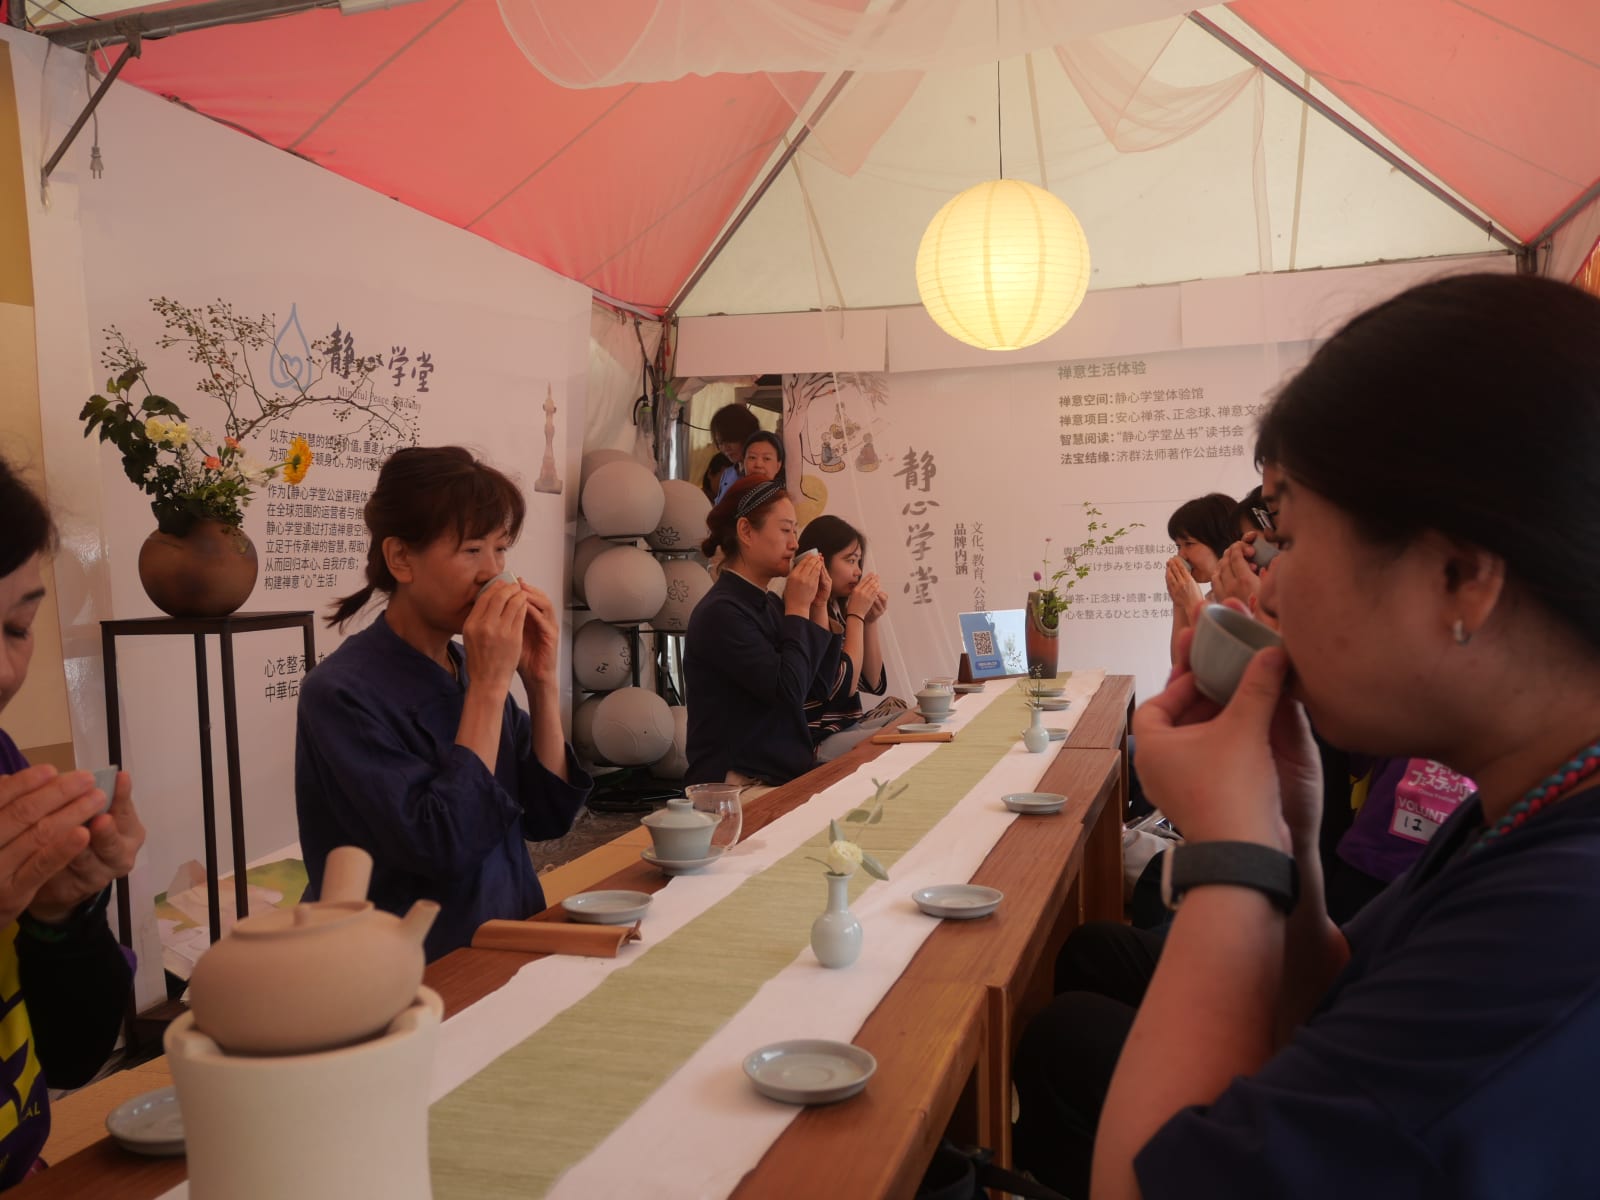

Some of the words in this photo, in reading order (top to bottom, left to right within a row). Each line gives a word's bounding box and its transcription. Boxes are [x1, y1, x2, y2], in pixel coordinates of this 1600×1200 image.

[1057, 361, 1147, 380] 禅意生活体验
[893, 446, 940, 604] 静心学堂
[265, 680, 301, 703] 中華伝
